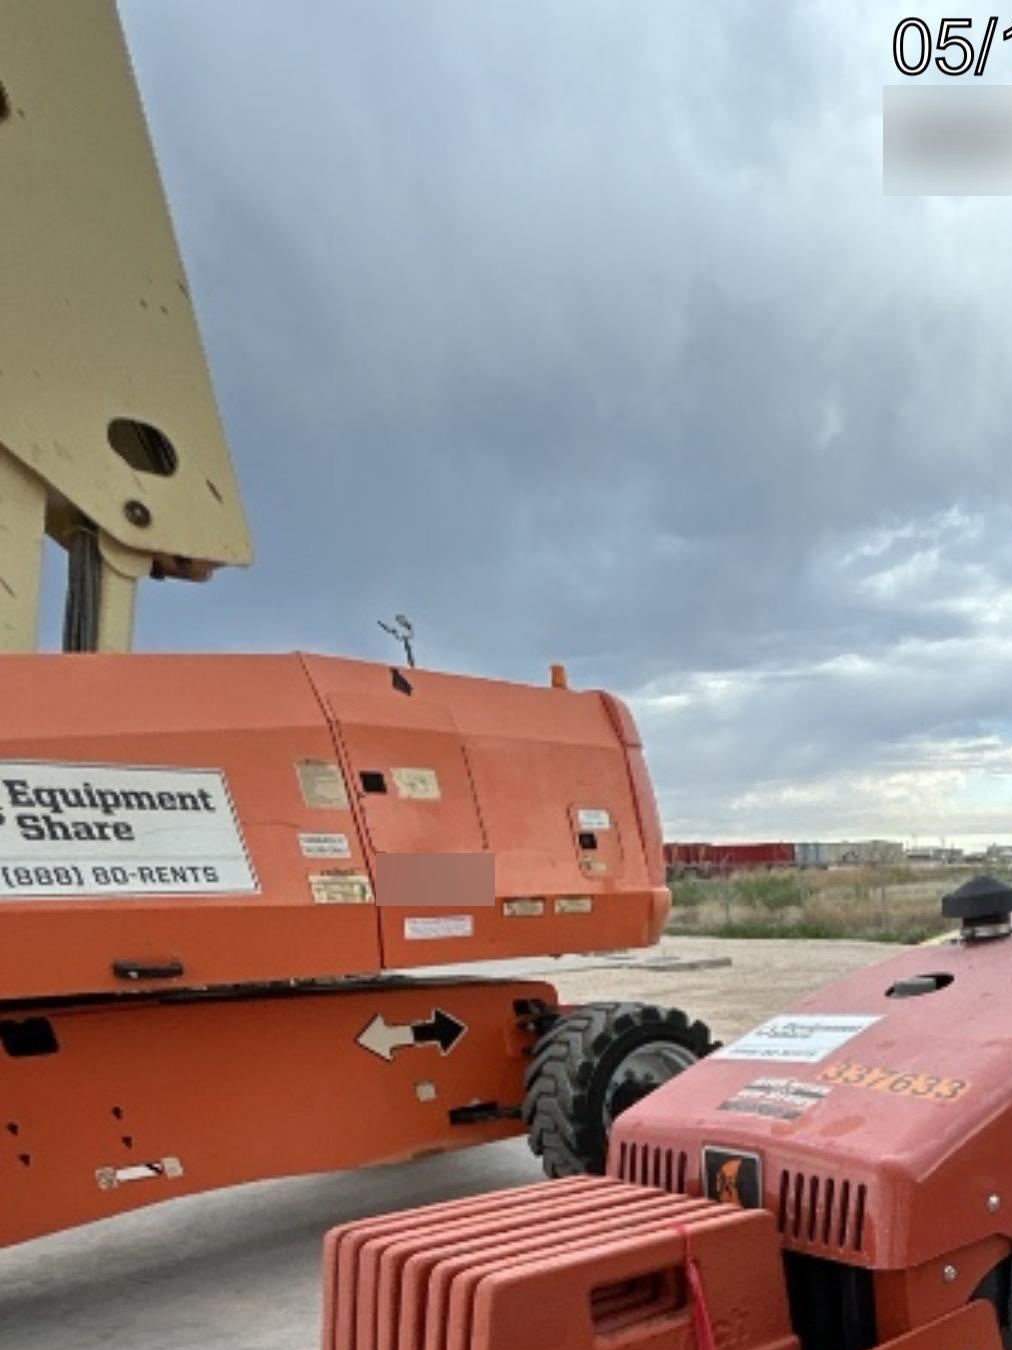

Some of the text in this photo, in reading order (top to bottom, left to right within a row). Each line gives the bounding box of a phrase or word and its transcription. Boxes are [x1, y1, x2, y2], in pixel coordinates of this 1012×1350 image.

[3, 779, 216, 815] Equipment
[17, 814, 135, 841] Share
[92, 865, 220, 884] 80-RENTS
[821, 1061, 966, 1100] 337633
